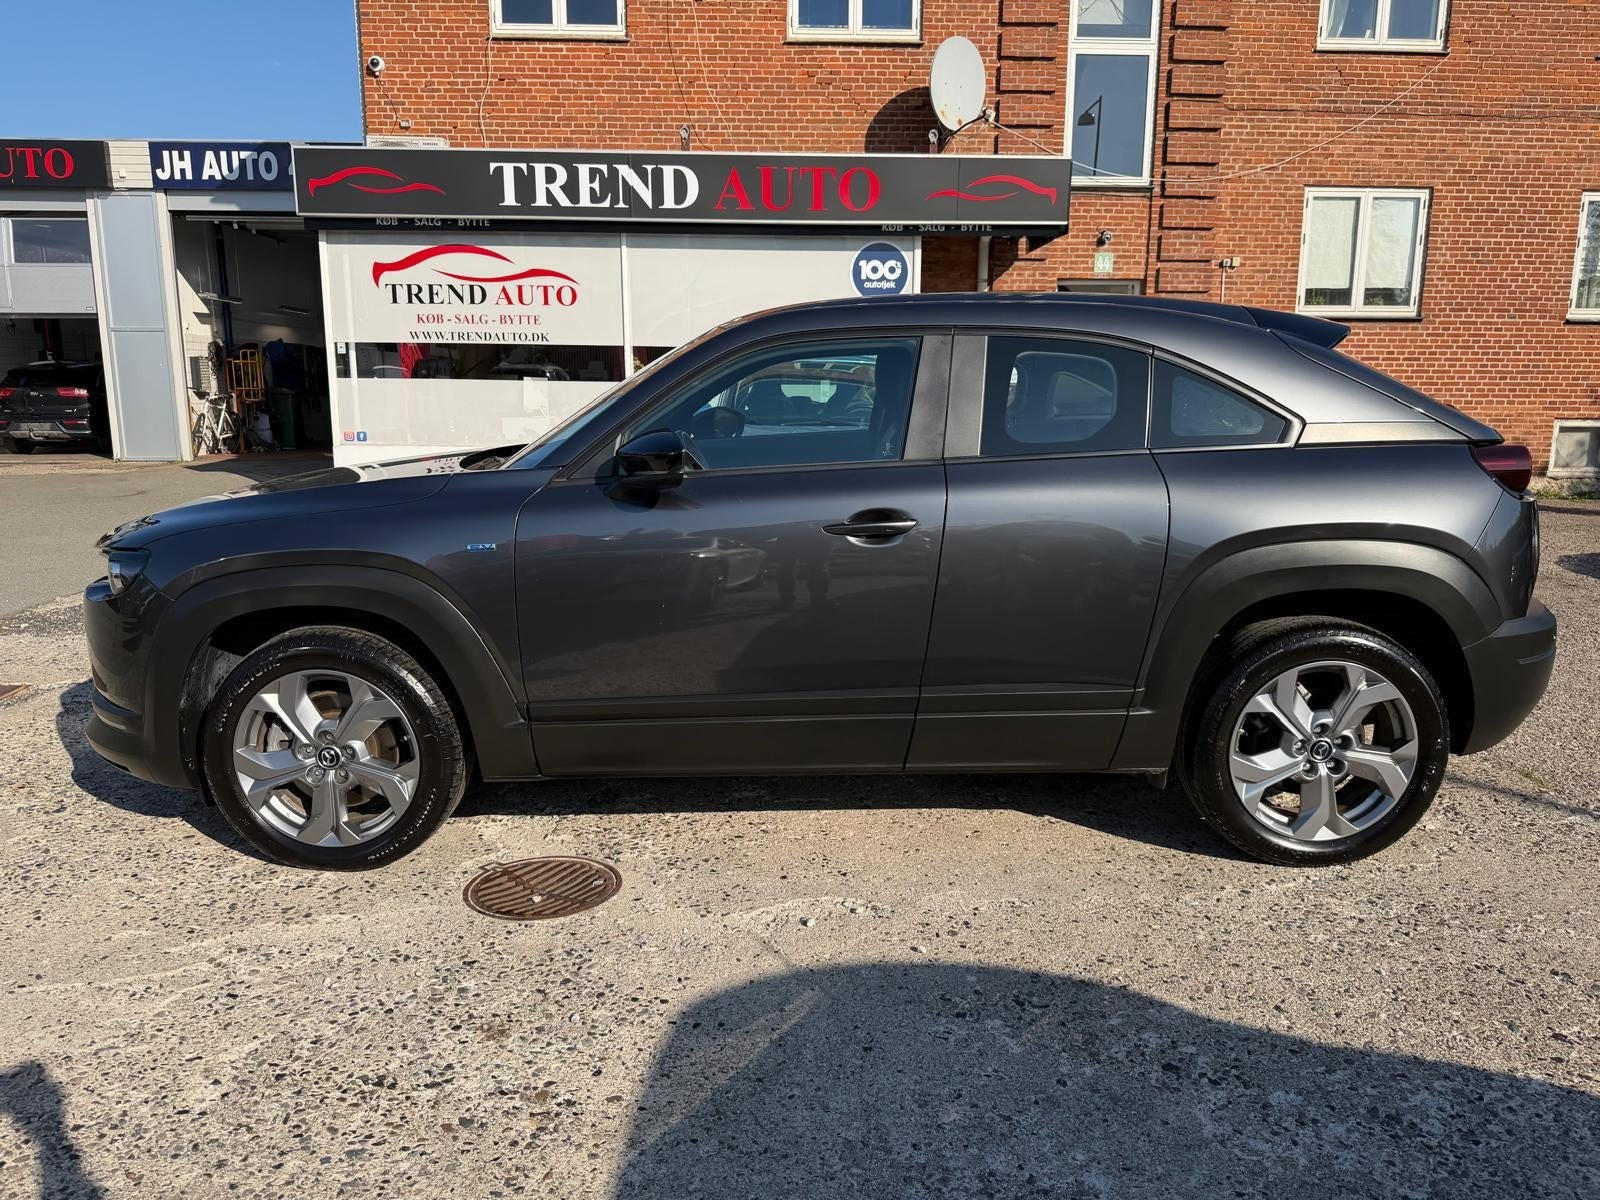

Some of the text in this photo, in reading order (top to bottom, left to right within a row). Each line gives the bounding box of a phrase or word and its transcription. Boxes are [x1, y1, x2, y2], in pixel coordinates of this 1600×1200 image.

[155, 150, 193, 181] JH
[201, 150, 279, 181] AUTO
[489, 161, 882, 212] TREND AUTO
[375, 217, 399, 226] KØB
[414, 217, 442, 226] SALG
[458, 218, 491, 227] BYTTE
[881, 223, 904, 232] KØB
[918, 223, 946, 232] SALG
[960, 223, 993, 232] BYTTE
[1097, 255, 1111, 270] 44
[863, 280, 896, 290] autotjek
[385, 282, 579, 308] TREND AUTO
[416, 313, 445, 326] KØB
[454, 314, 489, 326] SALG
[499, 314, 542, 327] BYTTE
[409, 330, 550, 344] WWW.TRENDAUTO.DK
